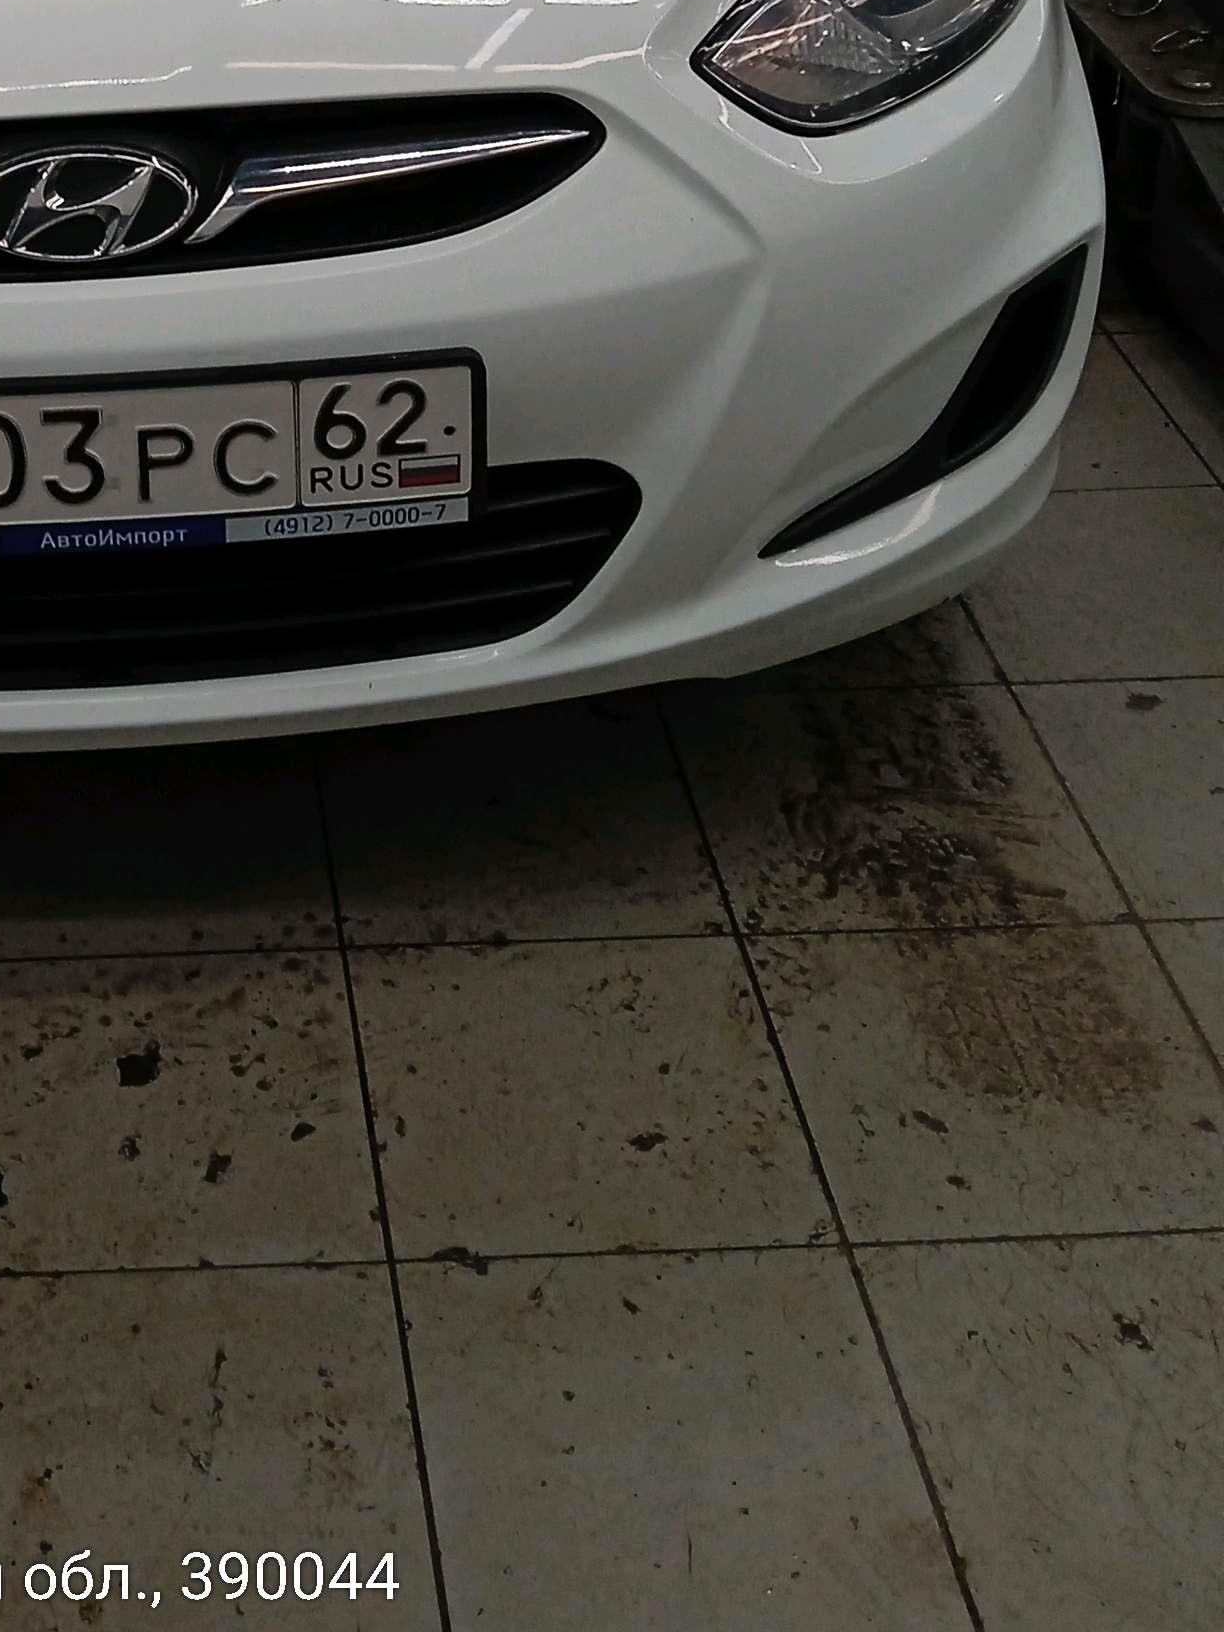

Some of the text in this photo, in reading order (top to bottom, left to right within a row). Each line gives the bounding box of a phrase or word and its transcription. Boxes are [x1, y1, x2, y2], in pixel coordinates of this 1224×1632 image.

[313, 377, 428, 460] 62
[310, 462, 394, 494] RUS
[264, 503, 447, 538] (4912) 7-0000-7
[40, 527, 188, 549] АвтоИмпорт
